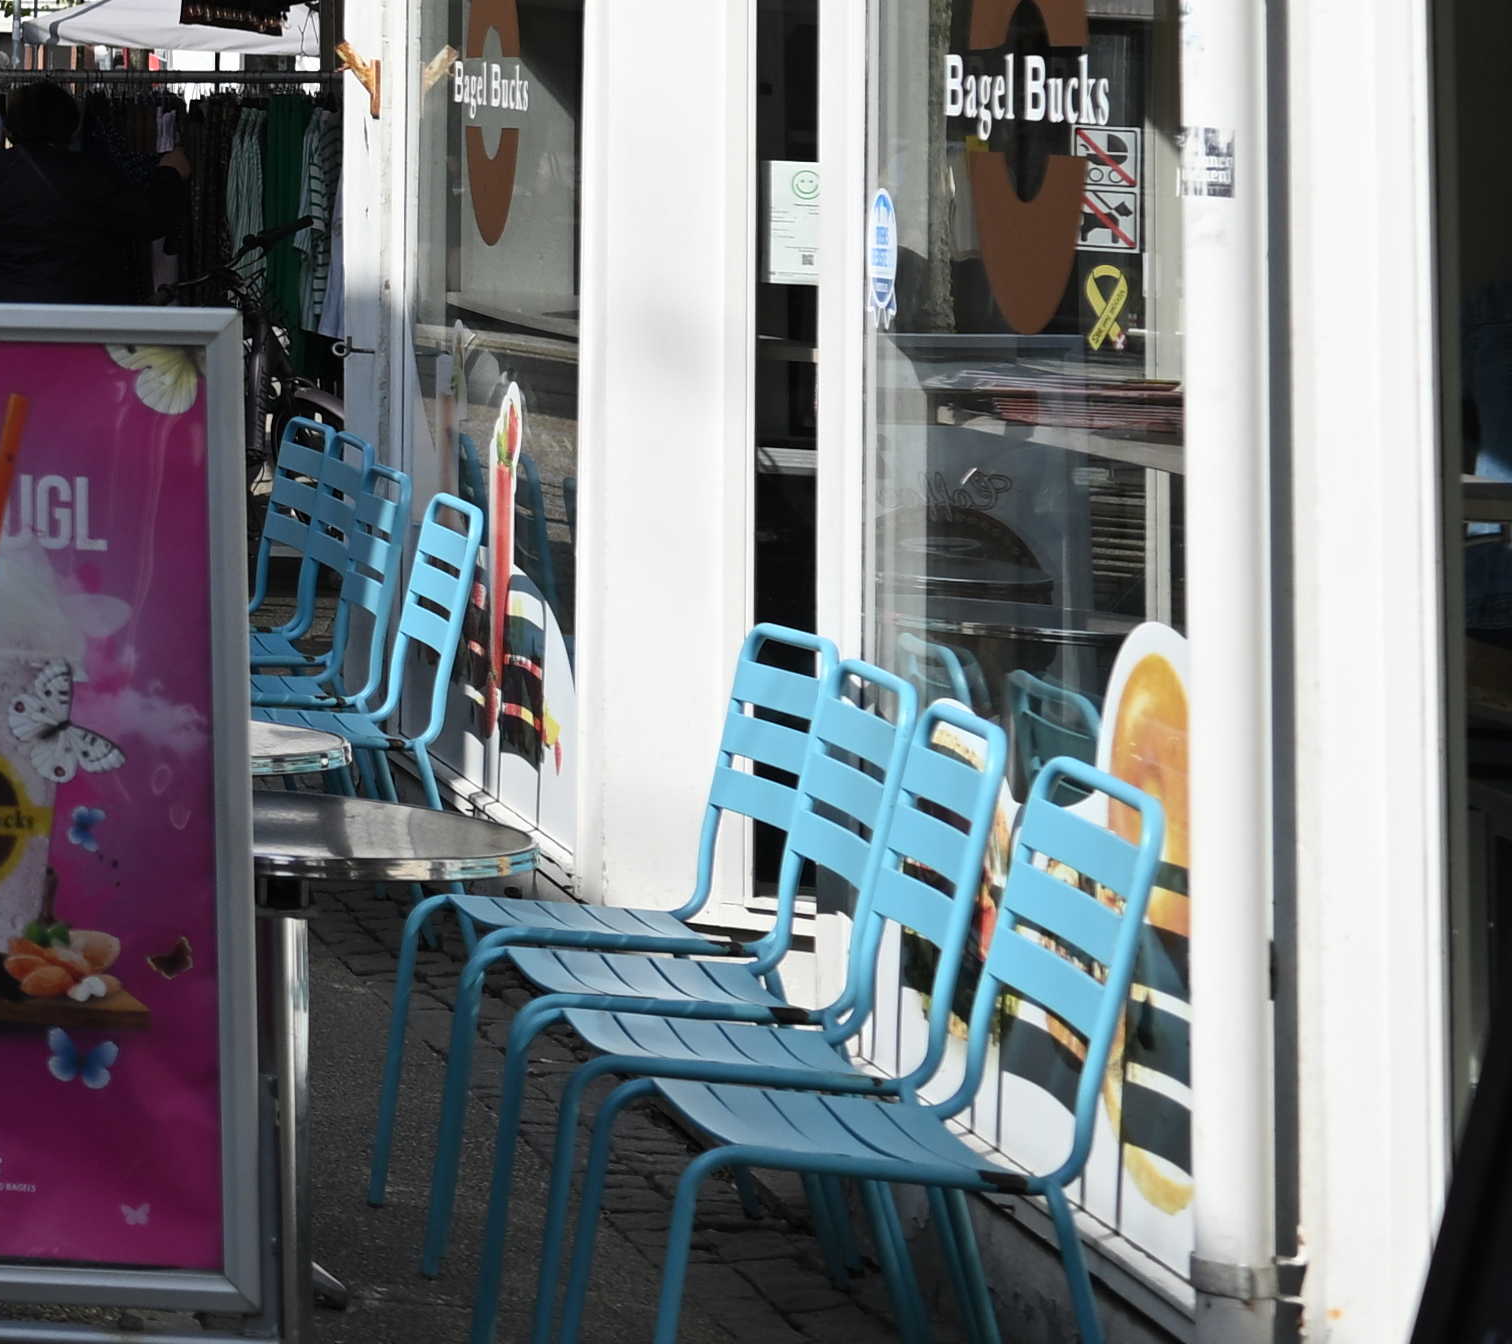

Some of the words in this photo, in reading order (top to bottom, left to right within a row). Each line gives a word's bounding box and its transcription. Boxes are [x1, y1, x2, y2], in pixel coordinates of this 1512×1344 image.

[454, 61, 487, 119] Bagel
[491, 63, 529, 111] Bucks
[944, 53, 1015, 141] Bagel
[1024, 54, 1110, 125] Bucks
